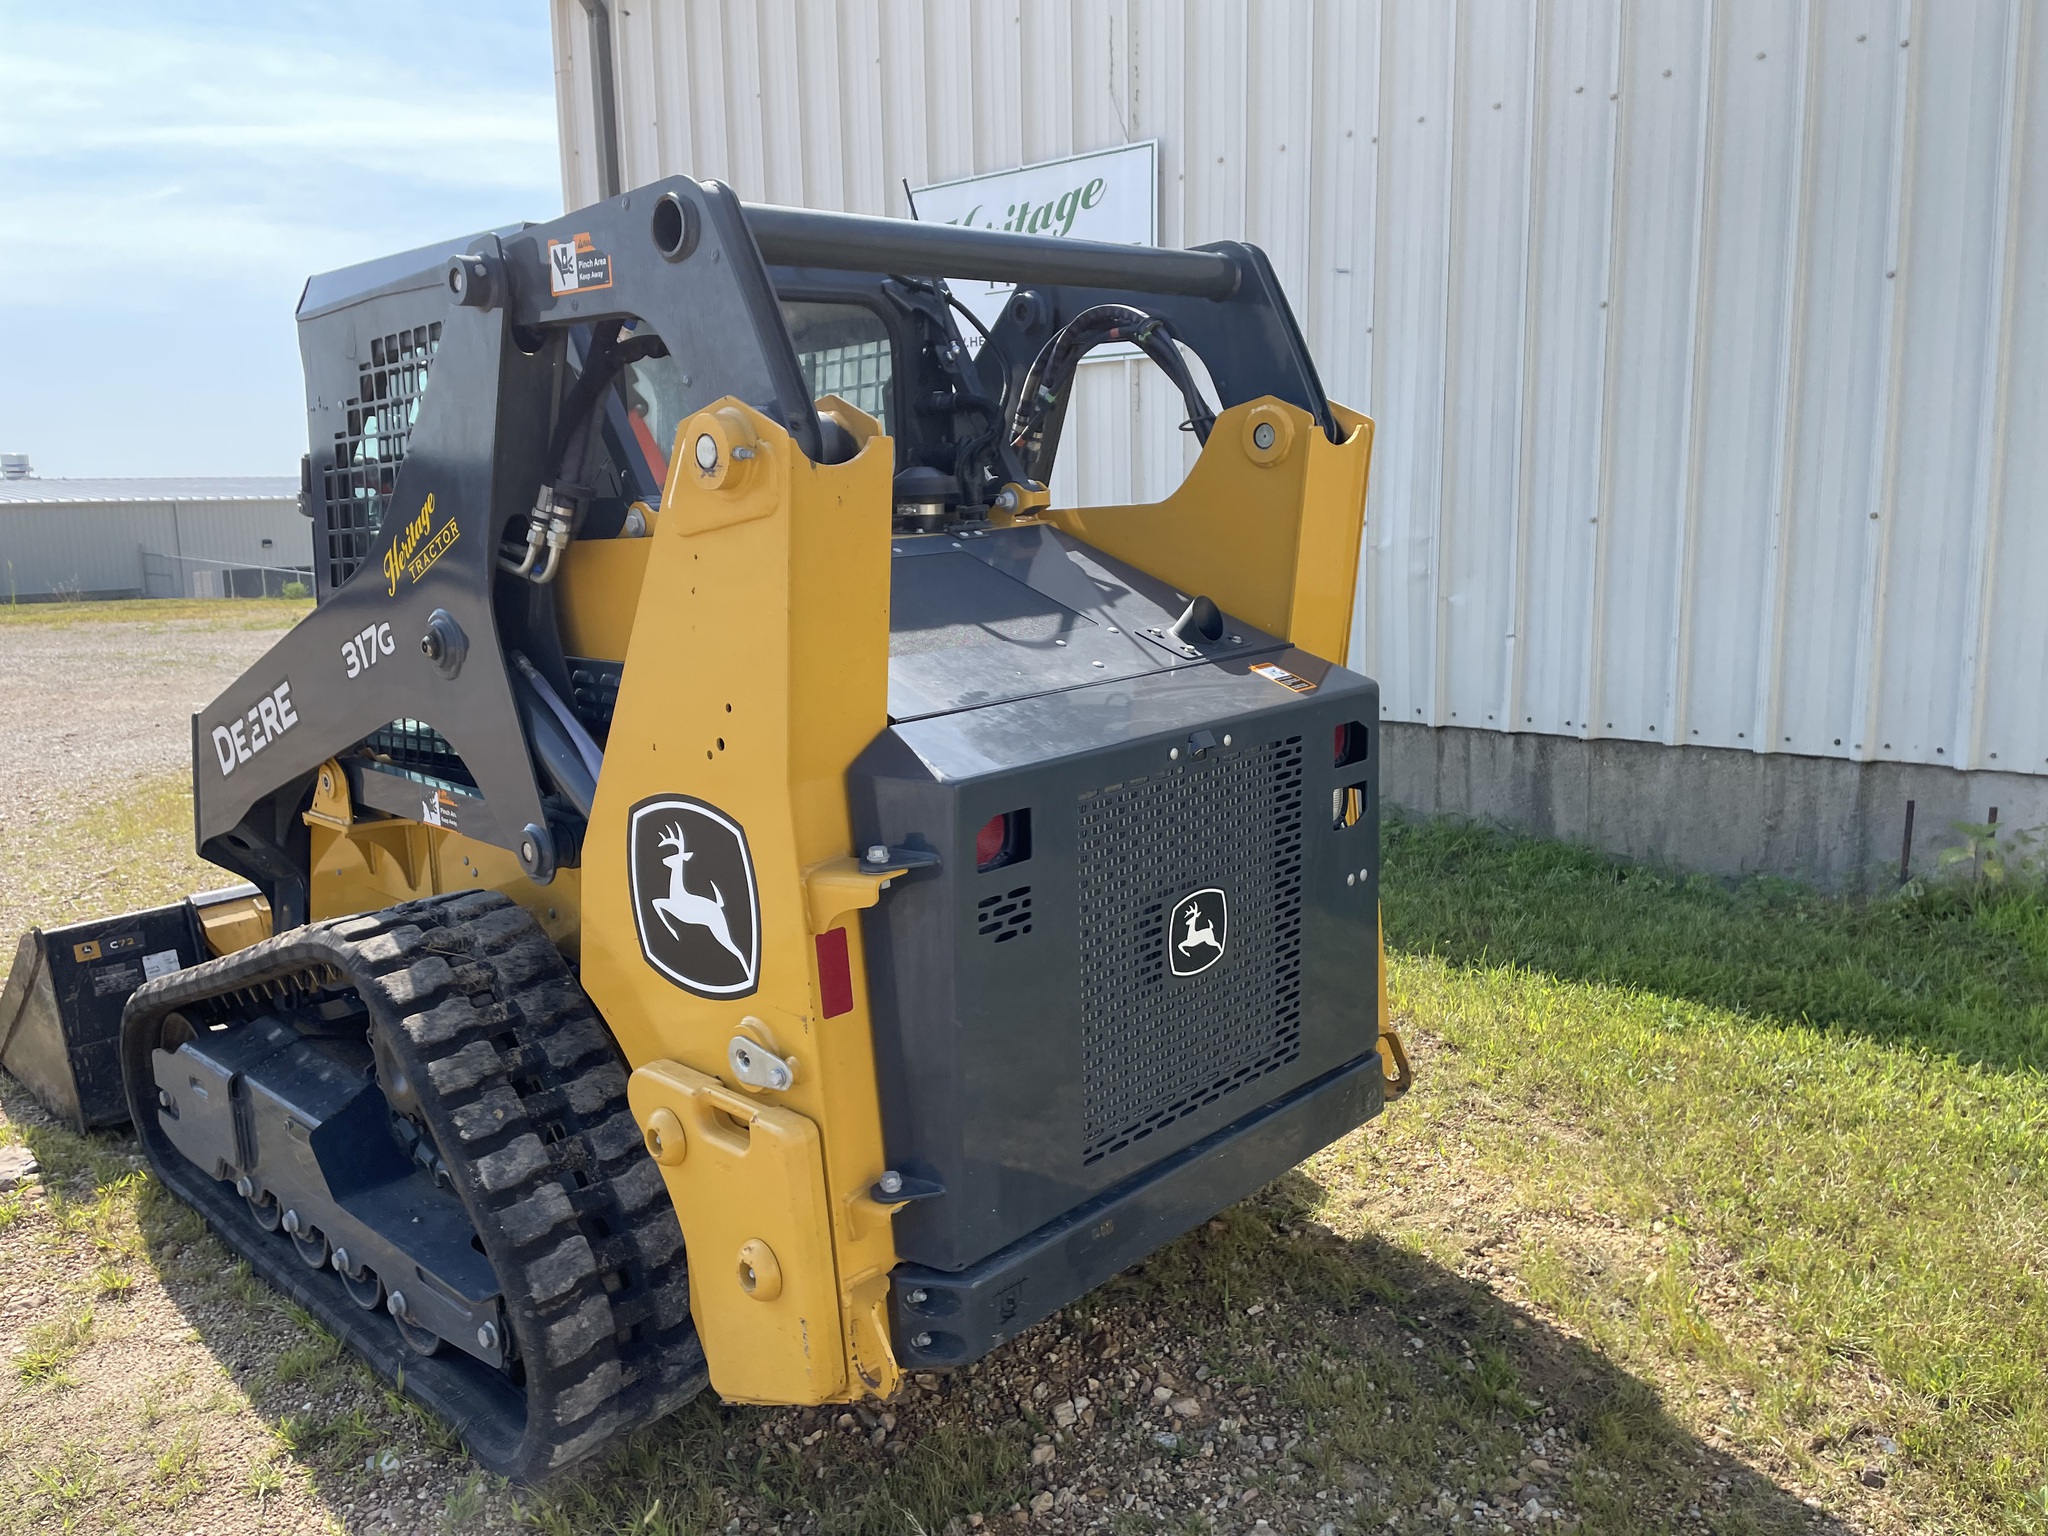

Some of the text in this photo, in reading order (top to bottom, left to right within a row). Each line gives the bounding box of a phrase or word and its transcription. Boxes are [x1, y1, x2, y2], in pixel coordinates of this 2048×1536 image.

[578, 257, 607, 269] Pinch Area
[383, 492, 436, 597] Heritage
[408, 520, 459, 579] TRACTOR
[341, 622, 396, 679] 317G
[211, 680, 299, 776] DEERE
[109, 937, 135, 949] C72
